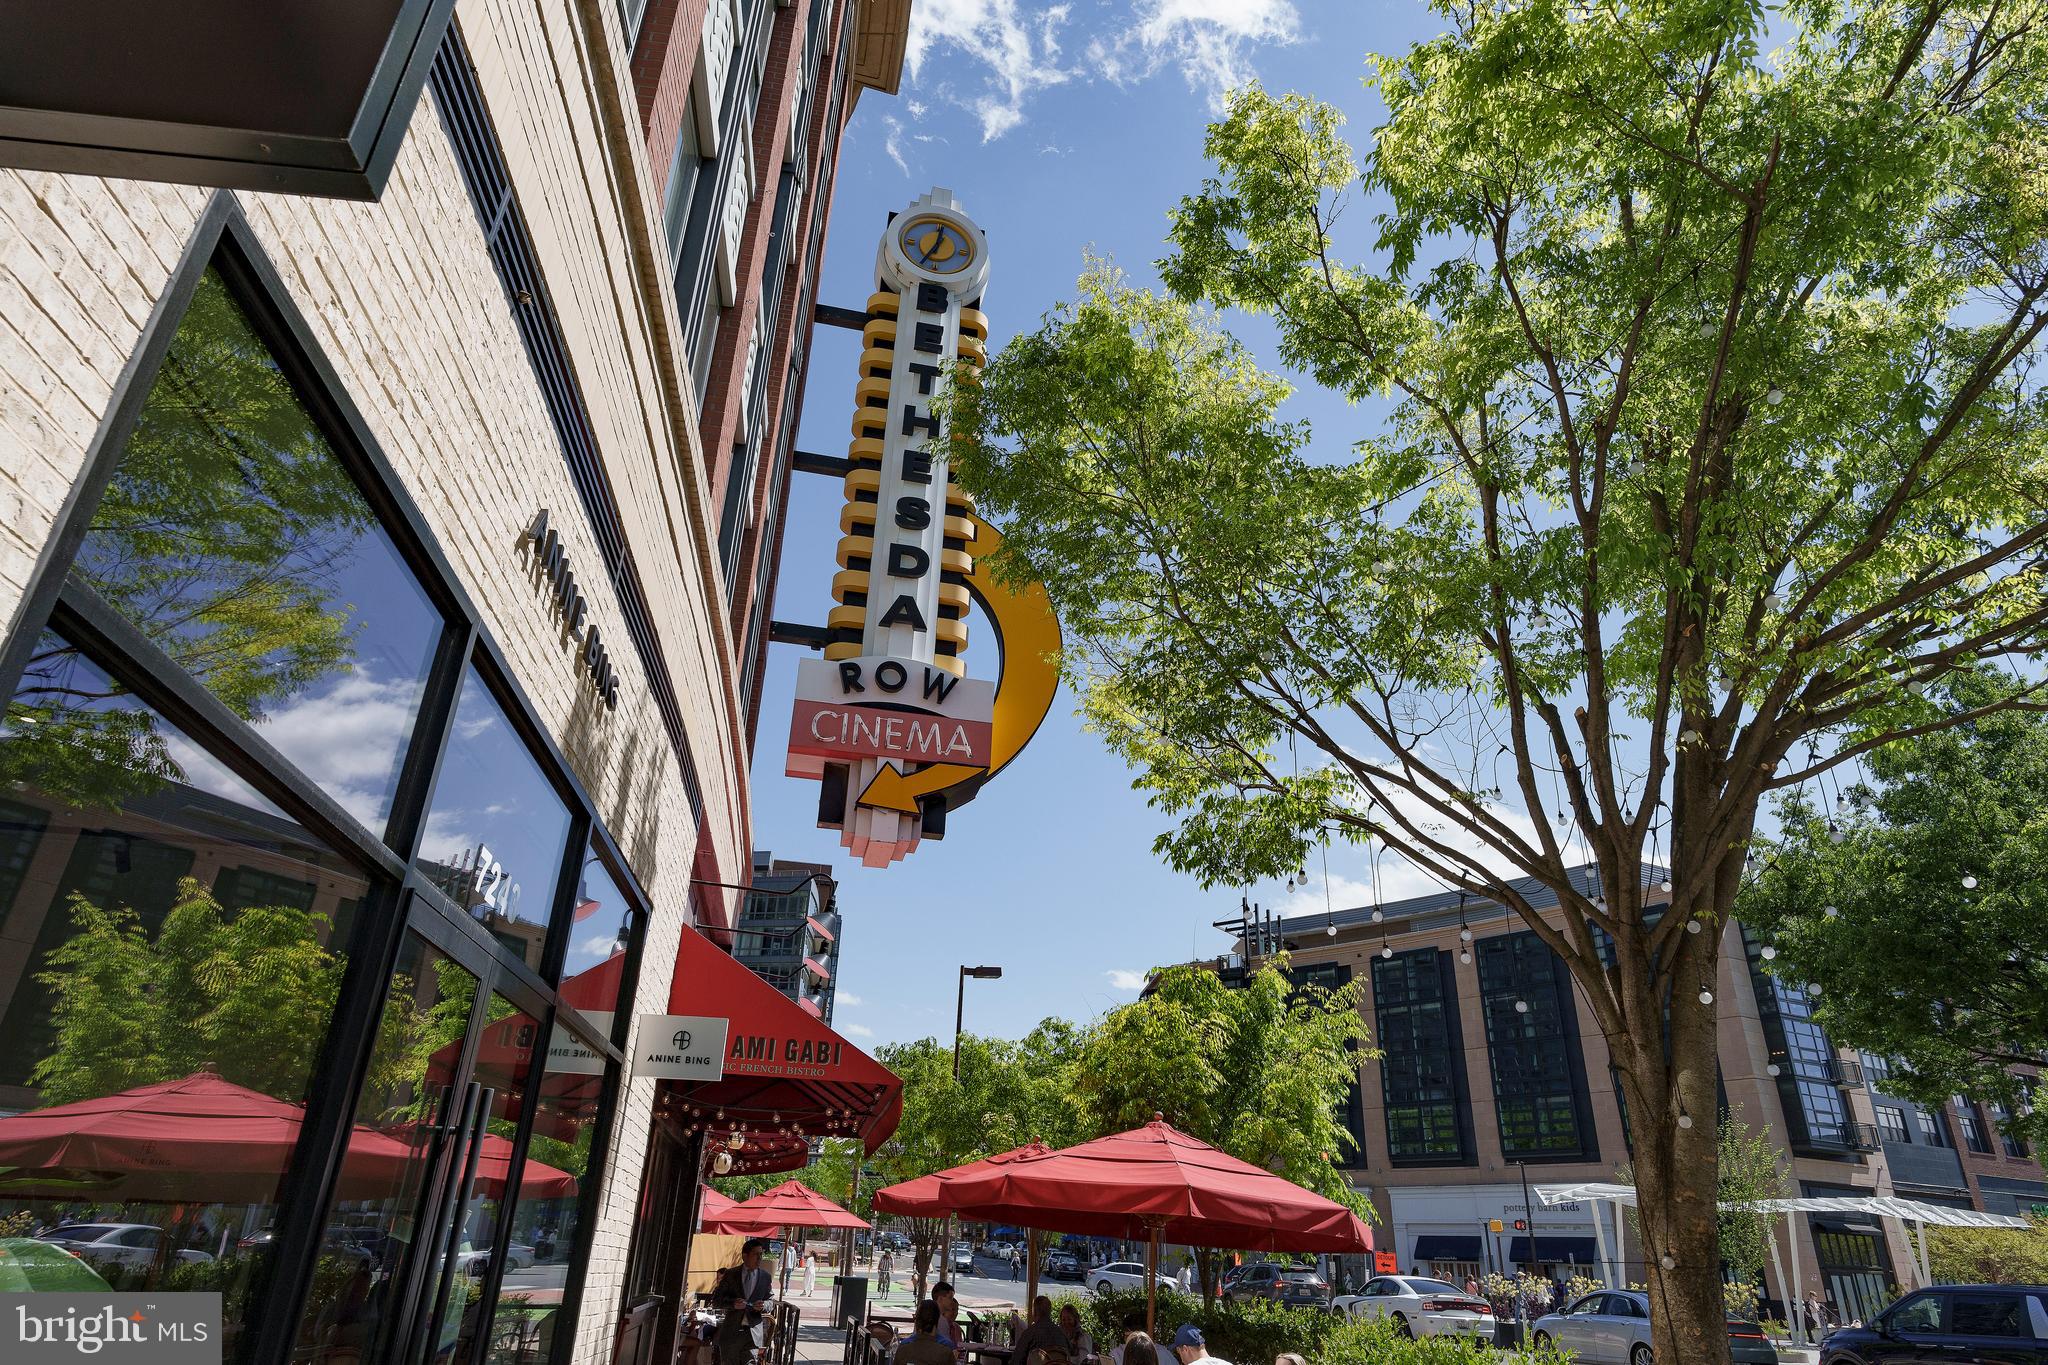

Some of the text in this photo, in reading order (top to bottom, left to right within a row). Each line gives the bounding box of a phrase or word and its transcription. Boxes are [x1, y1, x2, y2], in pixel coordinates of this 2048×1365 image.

[877, 282, 949, 633] BETHESDA
[838, 660, 960, 705] ROW
[811, 710, 975, 759] CINEMA
[647, 1054, 711, 1065] ANINE BING
[730, 1035, 842, 1067] AMI GABI
[739, 1063, 783, 1074] FRENCH
[787, 1066, 825, 1077] BISTRO
[1503, 1203, 1536, 1214] pottey
[1560, 1201, 1580, 1212] kids
